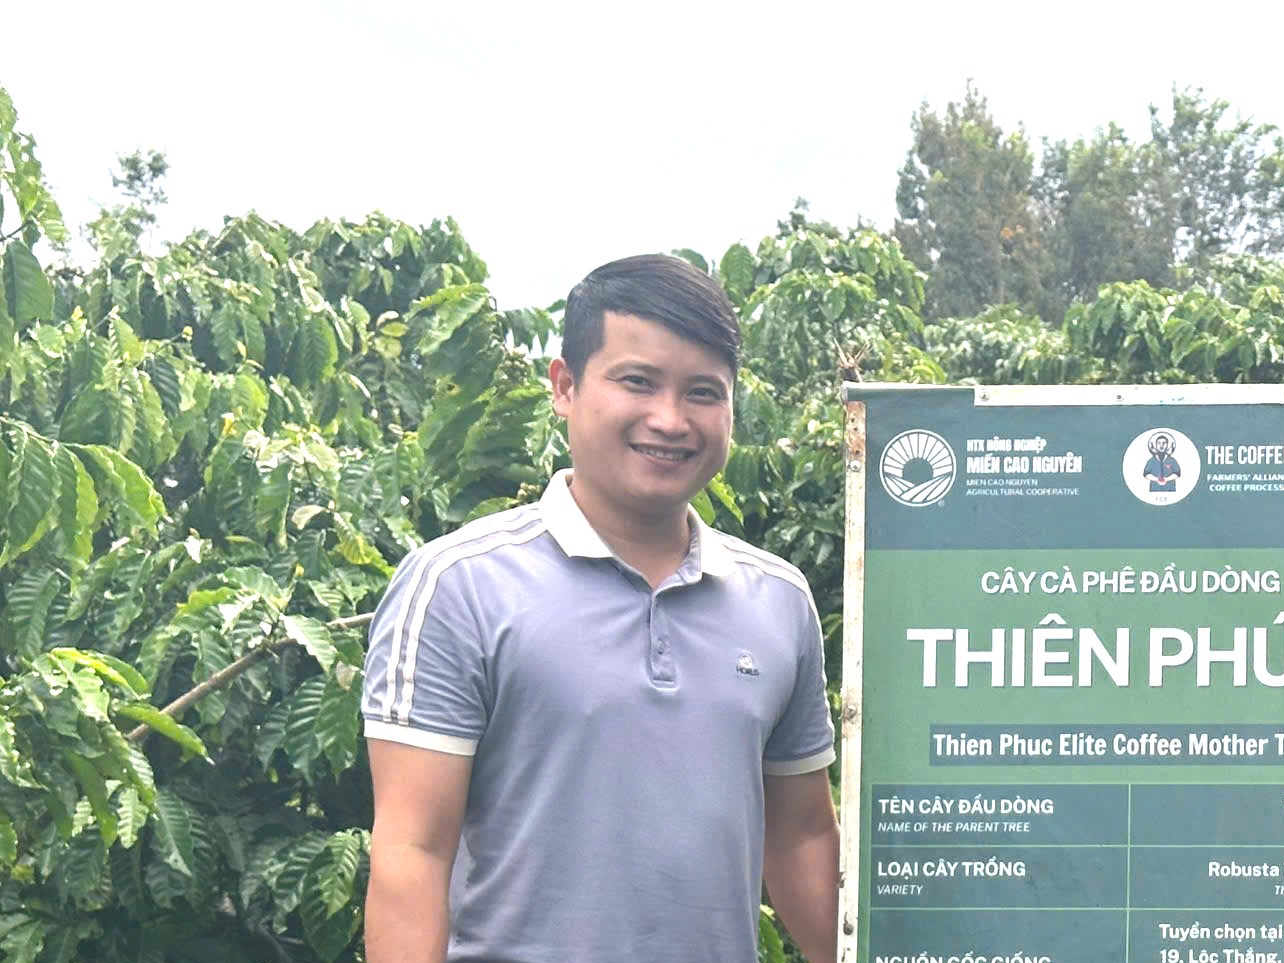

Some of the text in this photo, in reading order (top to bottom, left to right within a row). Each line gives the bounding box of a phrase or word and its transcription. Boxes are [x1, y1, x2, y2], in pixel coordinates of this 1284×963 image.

[1004, 457, 1029, 473] CAO
[1033, 452, 1082, 473] NGUYÊN
[1205, 446, 1234, 464] THE
[1210, 483, 1241, 492] COFFEE
[981, 563, 1280, 593] CÂY CÀ PHÊ ĐẦU DÒNG
[907, 613, 1129, 686] THIÊN
[933, 733, 992, 755] Thien
[1000, 734, 1052, 755] Phuc
[1060, 733, 1106, 755] Elite
[1113, 734, 1181, 755] Coffee
[1189, 734, 1268, 755] Mother
[879, 794, 1053, 814] TÊN CÂY ĐẦU DÒNG
[879, 821, 1029, 833] NAME OF THE PARENT TREE
[878, 862, 918, 880] LOẠI
[923, 859, 958, 876] CÂY
[1209, 861, 1279, 877] Robusta
[878, 884, 923, 895] VARIETY
[1159, 922, 1210, 941] Tuyển
[1214, 924, 1255, 942] chọn
[1260, 924, 1282, 942] tại
